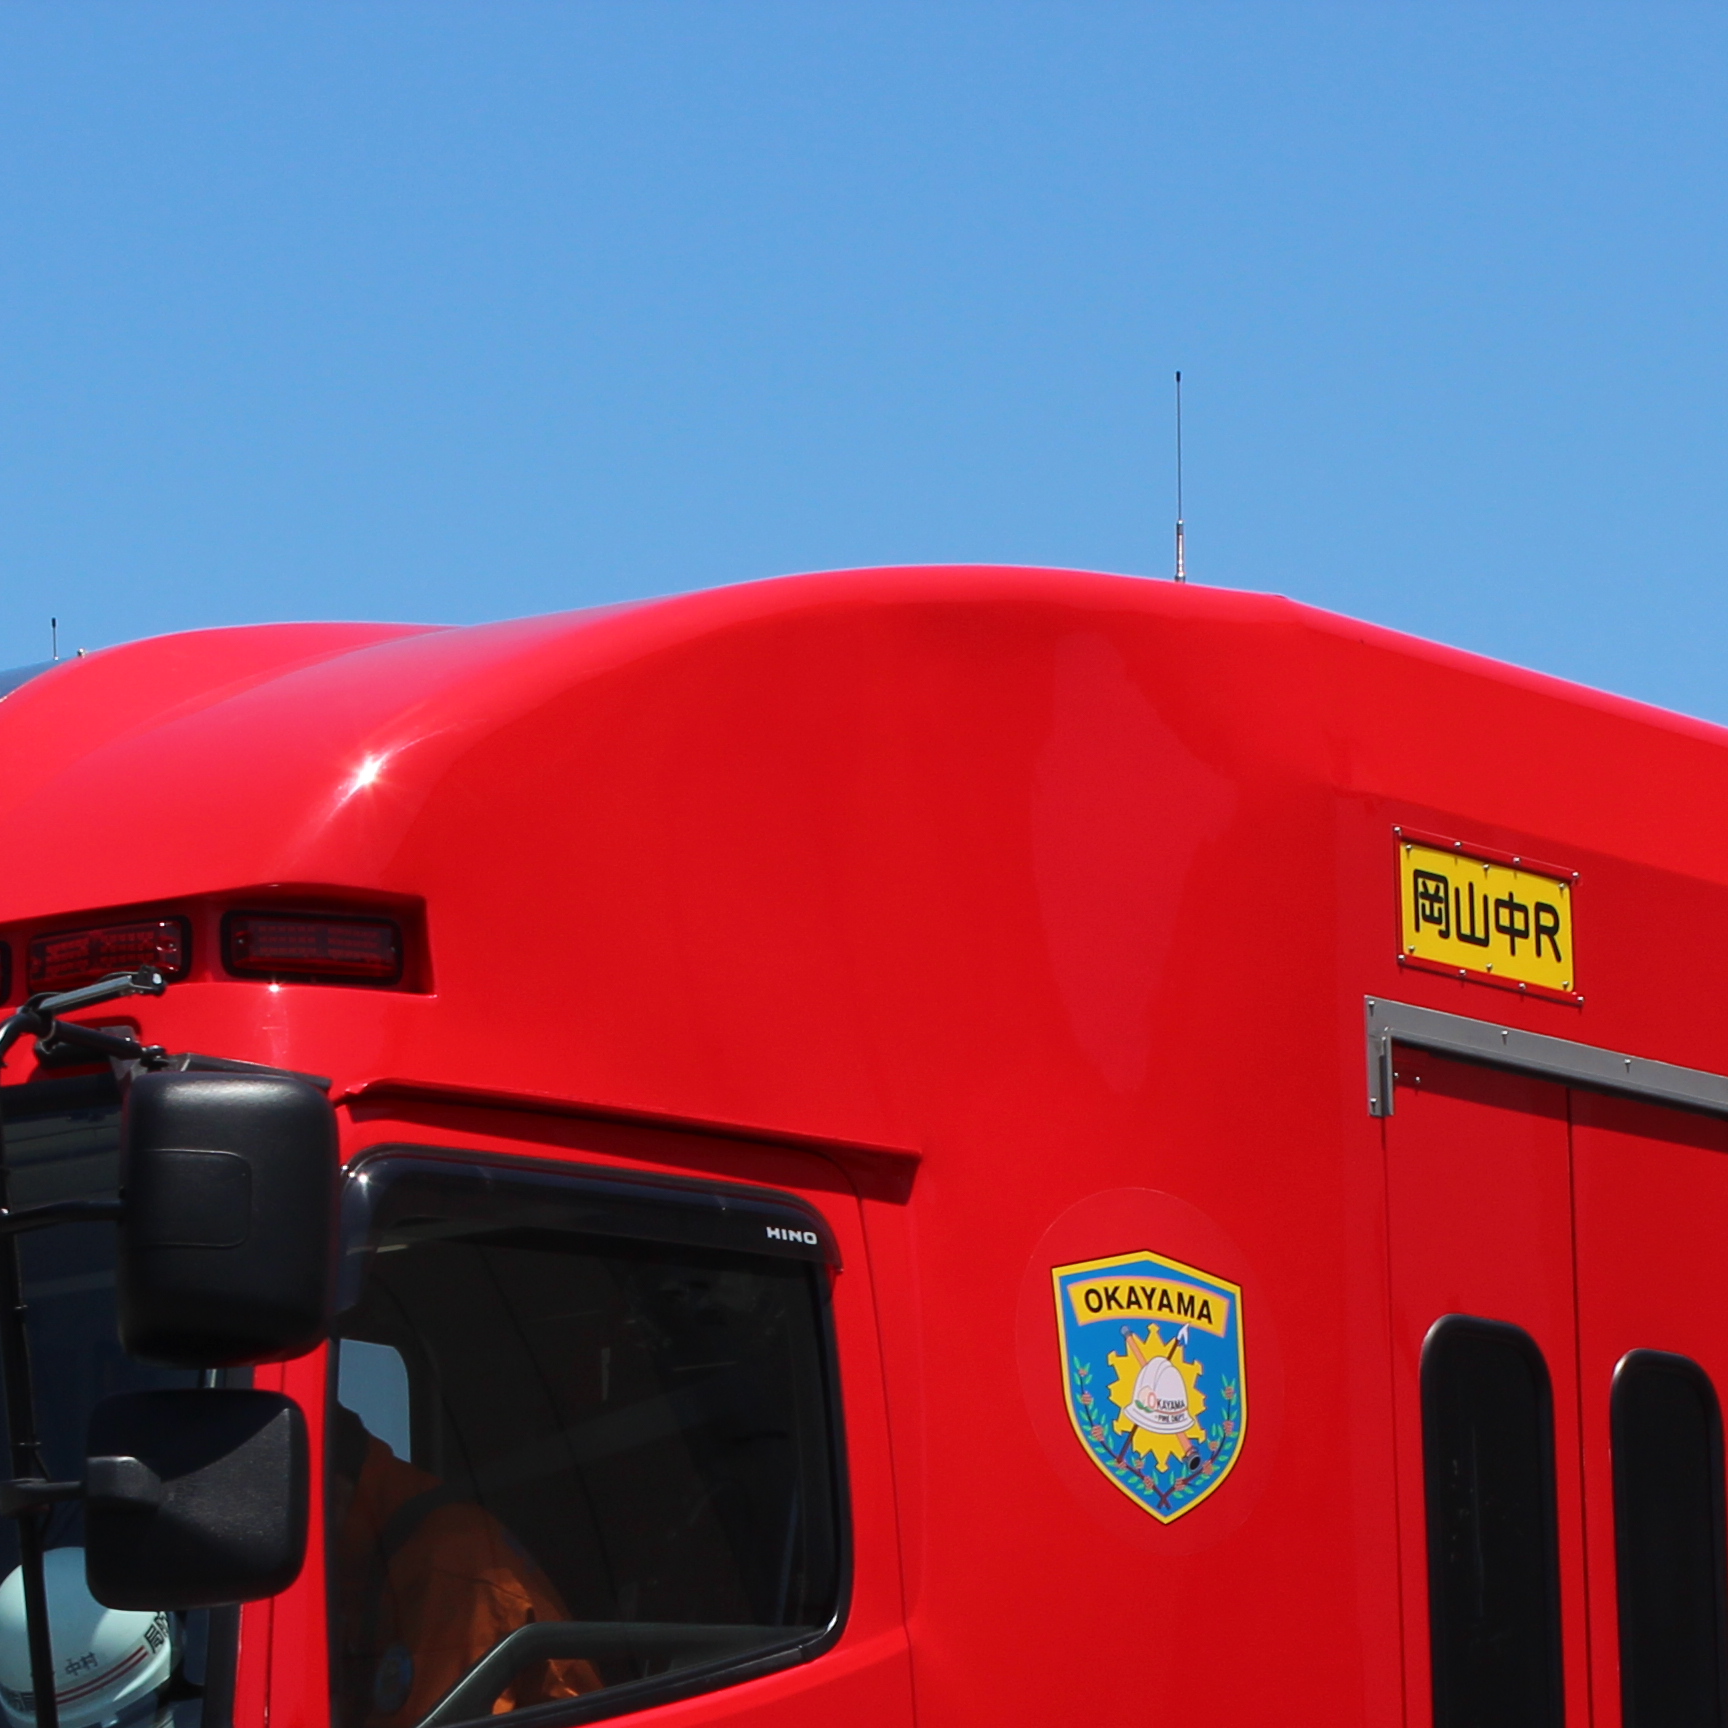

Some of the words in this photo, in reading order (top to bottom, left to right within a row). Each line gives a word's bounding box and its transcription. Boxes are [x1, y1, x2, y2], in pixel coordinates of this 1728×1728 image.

[1413, 868, 1562, 963] 岡山中R
[766, 1226, 818, 1245] HINO
[1084, 1286, 1213, 1325] OKAYAMA
